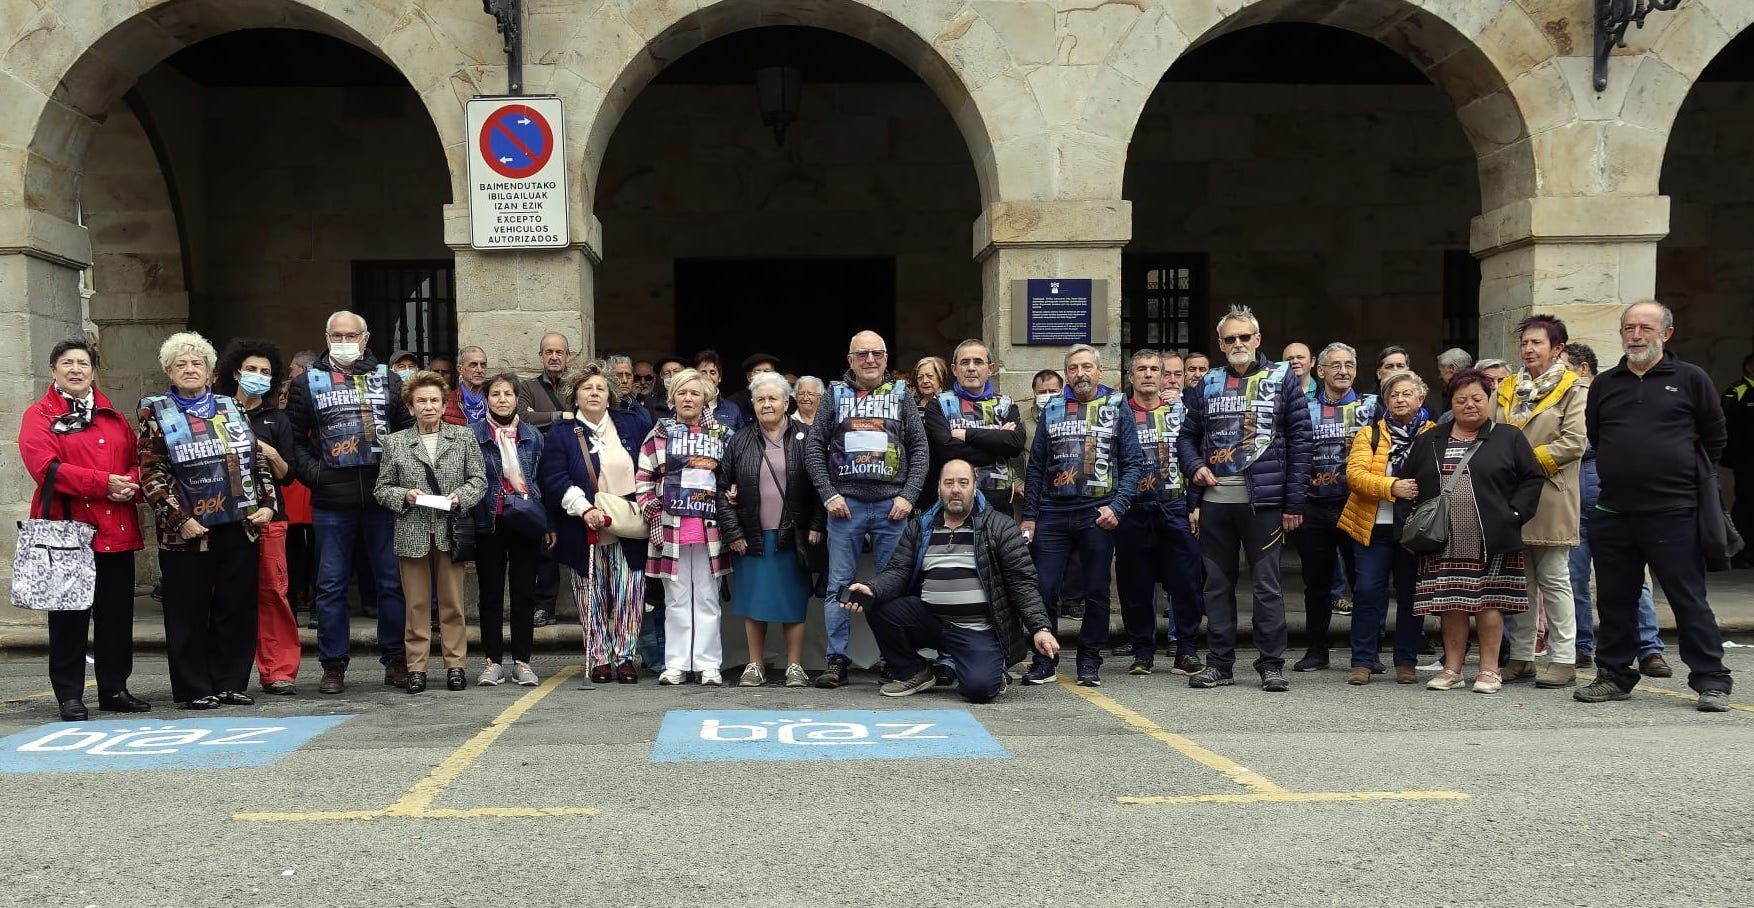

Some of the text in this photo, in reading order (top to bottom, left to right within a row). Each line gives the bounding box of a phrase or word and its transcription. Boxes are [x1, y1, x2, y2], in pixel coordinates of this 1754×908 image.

[479, 181, 556, 191] BAIMENDUTAKO
[488, 192, 548, 200] IBILGAILUAK
[494, 202, 544, 210] IZAN EZIK
[497, 215, 542, 223] EXCEPTO
[493, 225, 549, 233] VEHICULOS
[488, 234, 559, 244] AUTORIZADOS
[331, 434, 360, 457] aek
[1087, 405, 1115, 487] korrika
[1161, 411, 1181, 489] korrika
[1209, 445, 1237, 464] aek
[224, 420, 258, 509] korrika
[1053, 465, 1078, 487] aek
[193, 490, 228, 516] aek
